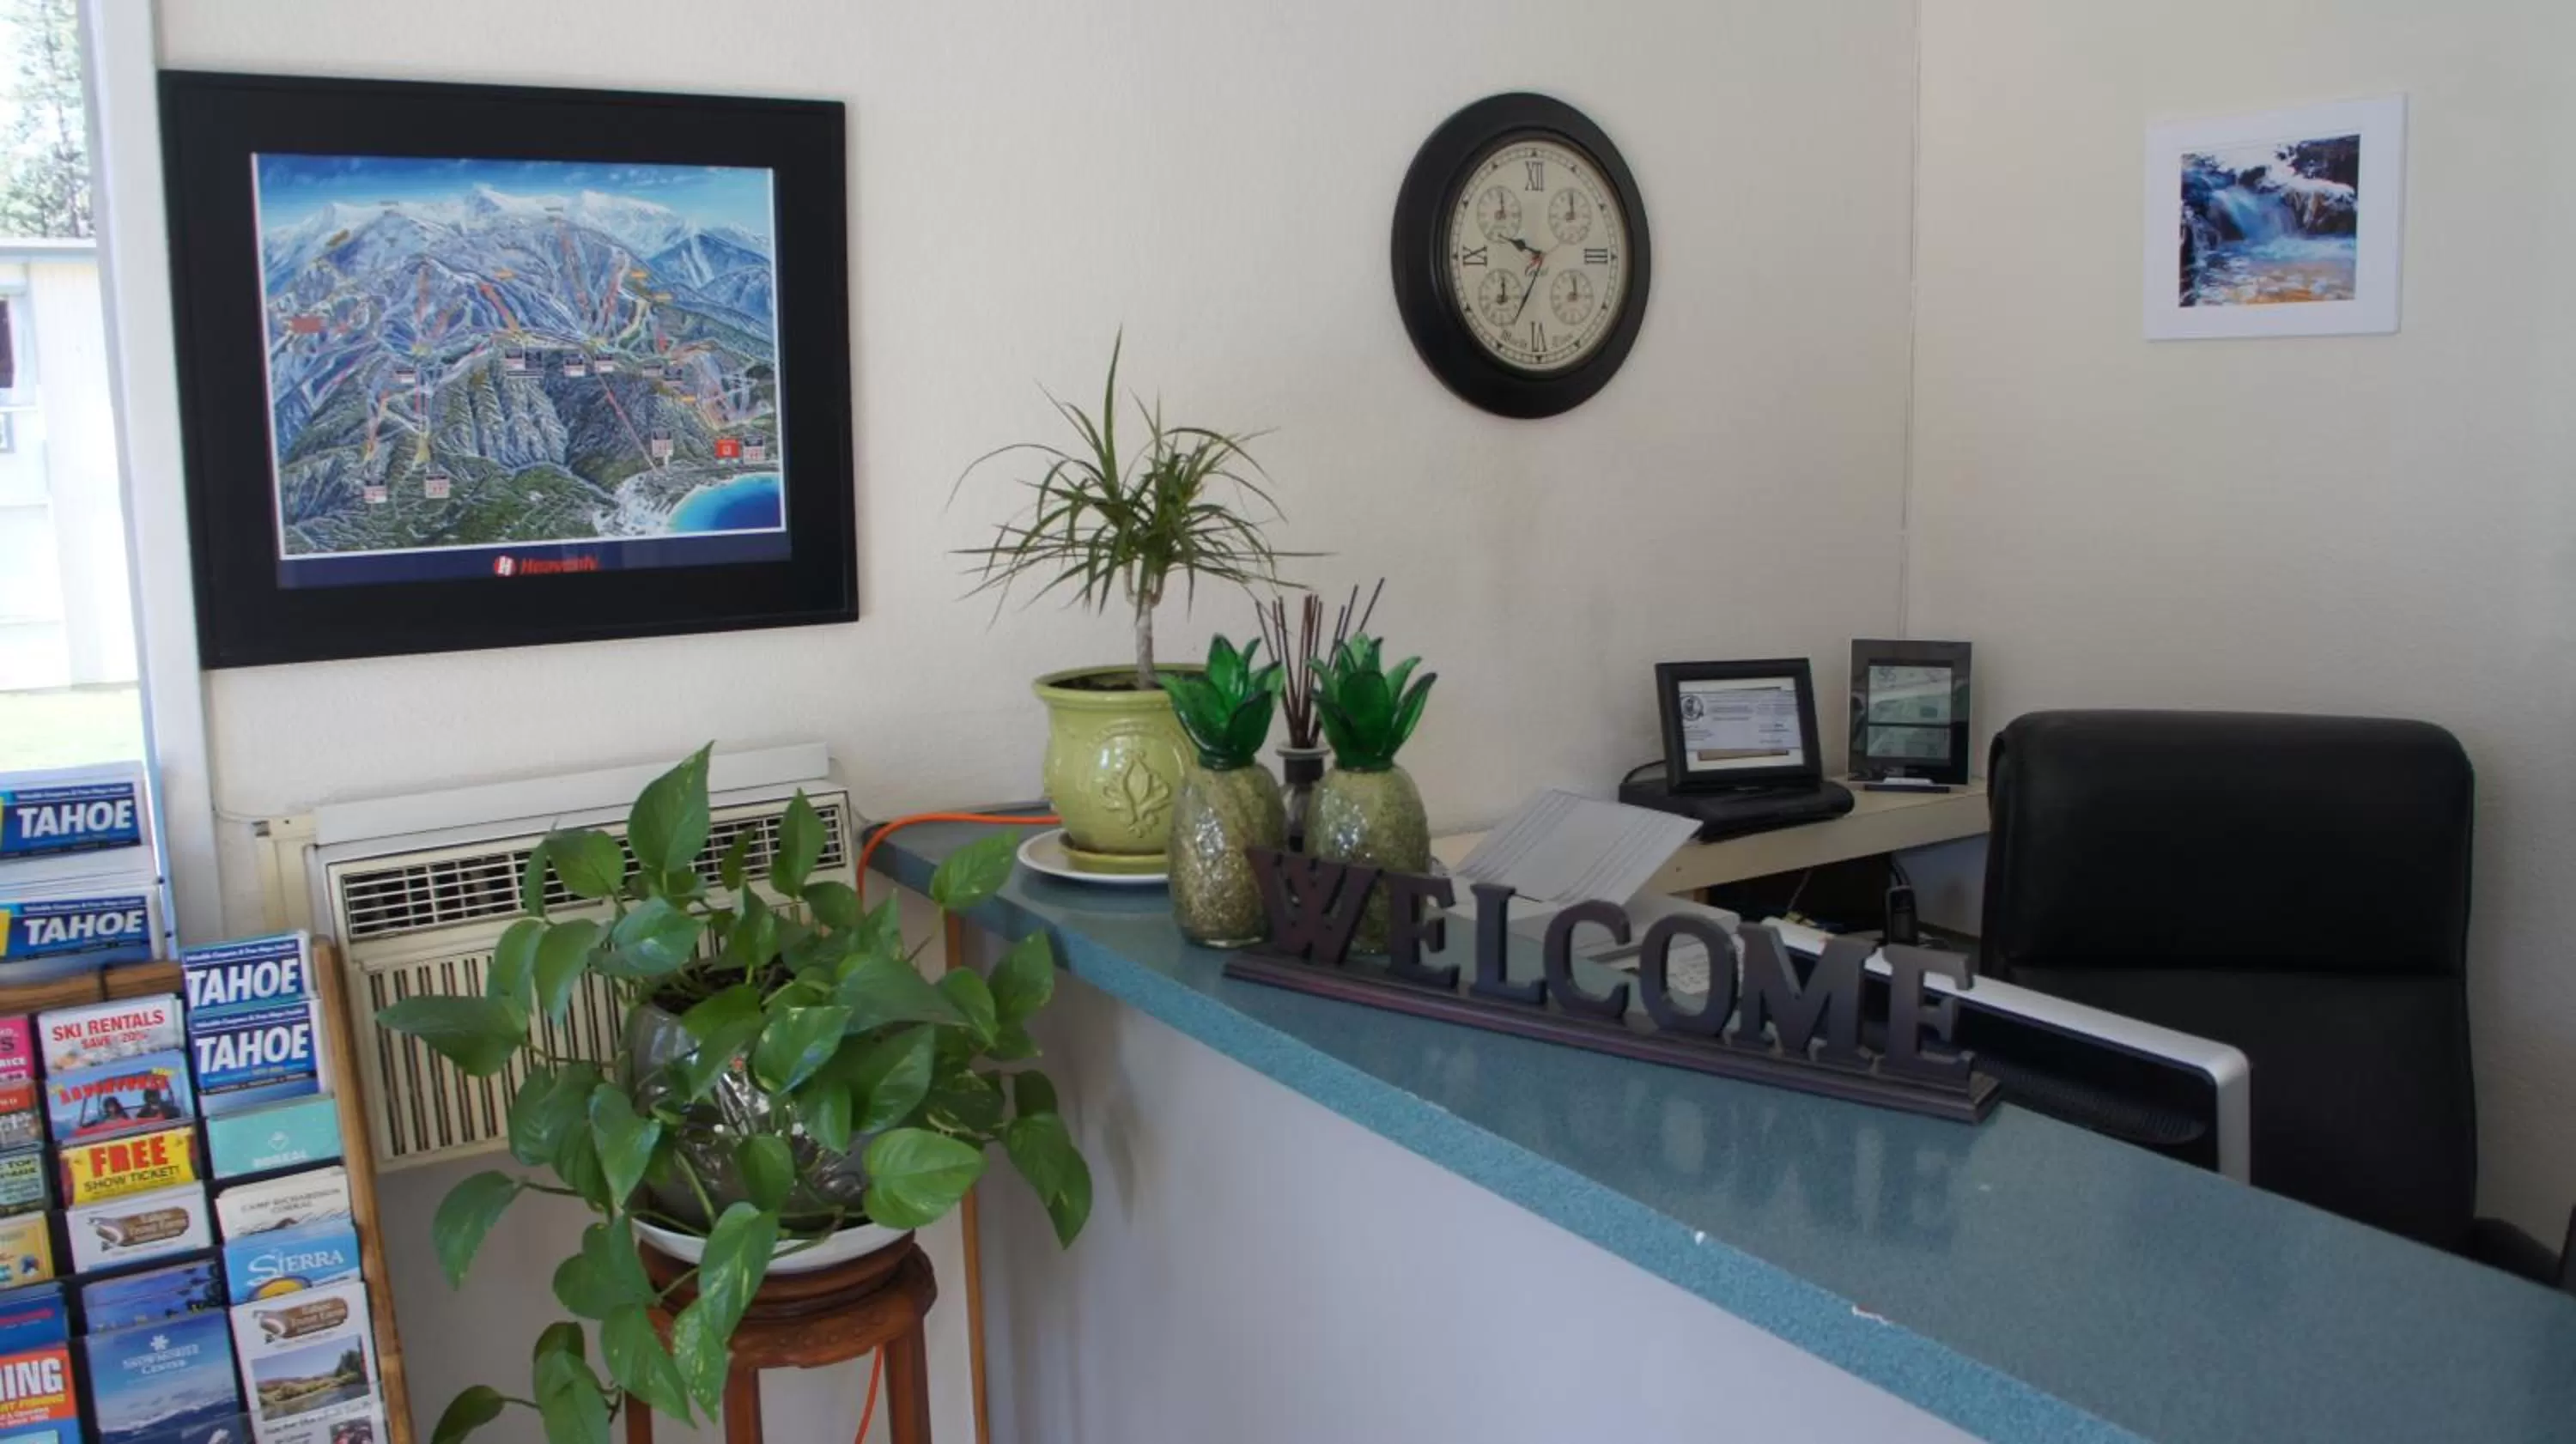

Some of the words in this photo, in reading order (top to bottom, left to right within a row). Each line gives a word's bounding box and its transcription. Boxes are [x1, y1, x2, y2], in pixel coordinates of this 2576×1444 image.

[17, 799, 134, 839] TAHOE
[24, 910, 145, 947] TAHOE
[185, 958, 299, 1009] TAHOE
[1247, 847, 1978, 1082] WELCOME
[52, 1022, 82, 1042] SKI
[88, 1009, 165, 1035] RENTALS
[195, 1023, 310, 1074] TAHOE
[90, 1135, 169, 1179] FREE
[84, 1175, 127, 1192] SHOW
[246, 1248, 344, 1277] SIERRA
